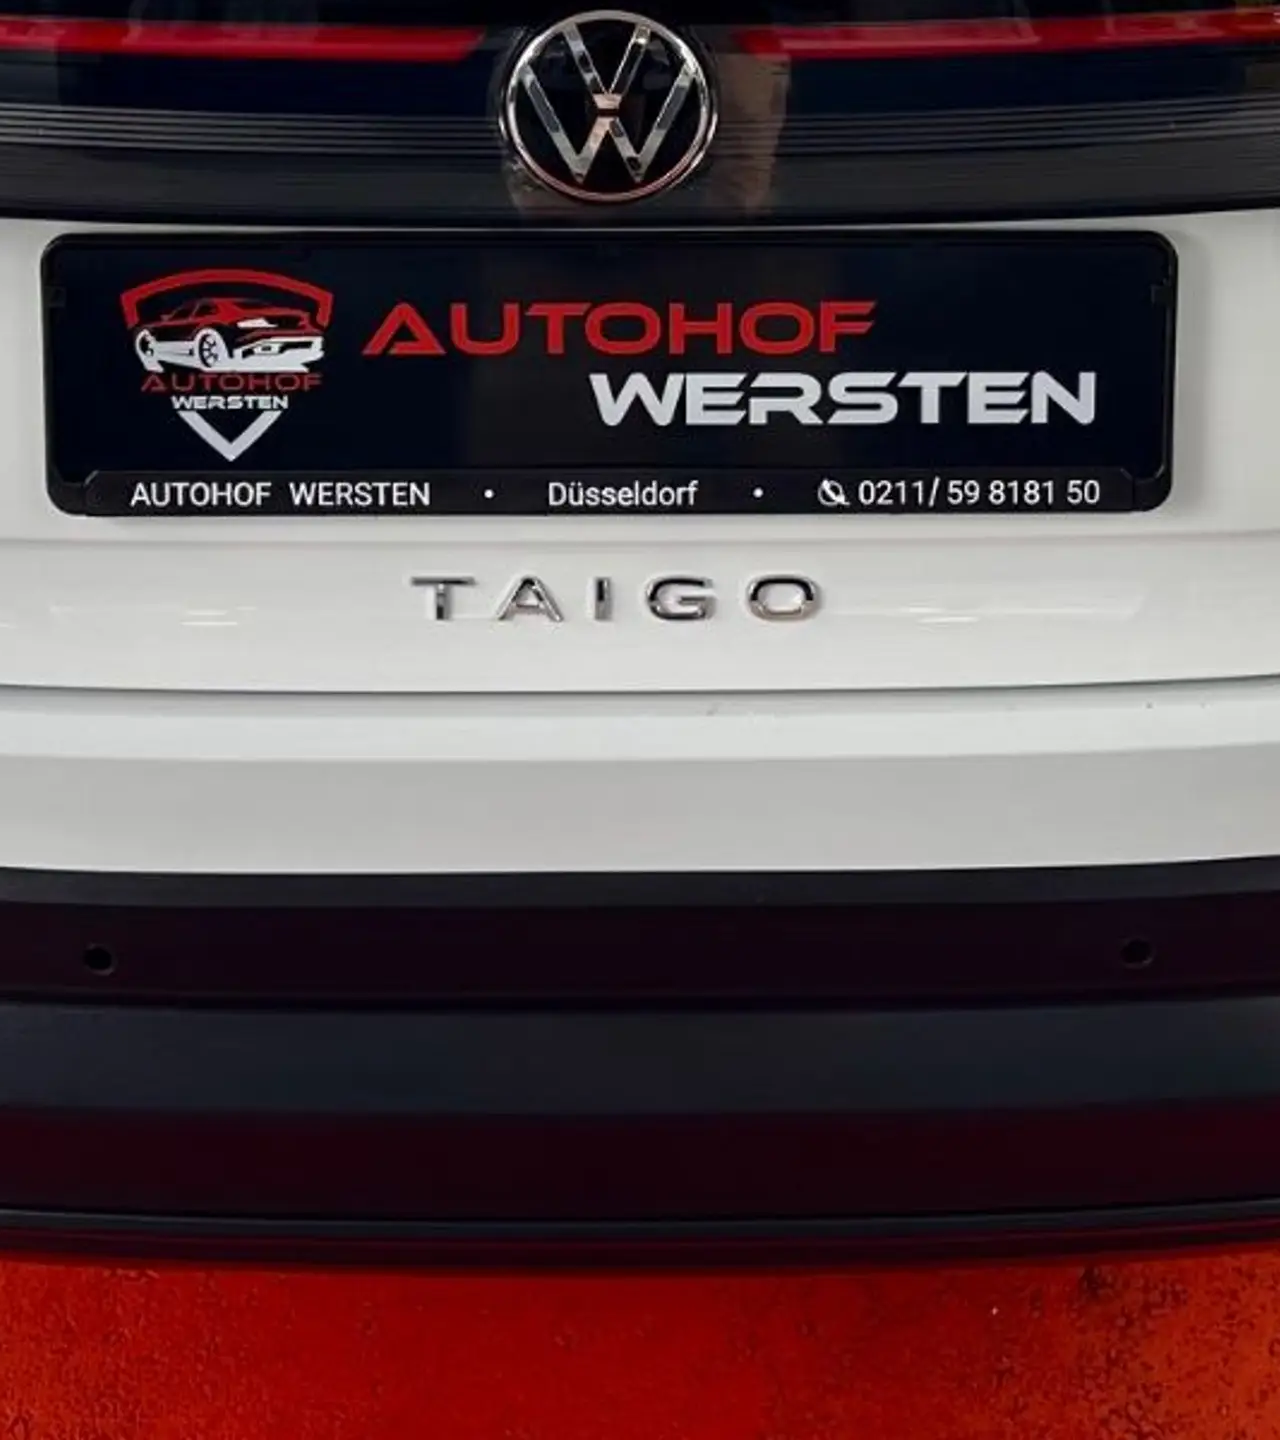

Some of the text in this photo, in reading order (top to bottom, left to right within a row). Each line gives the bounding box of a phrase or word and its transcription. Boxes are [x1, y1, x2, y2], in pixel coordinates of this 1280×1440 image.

[362, 301, 877, 356] AUTOHOF
[140, 372, 323, 392] AUTOHOF
[589, 371, 1097, 427] WERSTEN
[171, 395, 289, 410] WERSTEN
[130, 481, 272, 507] AUTOHOF
[289, 481, 431, 507] WERSTEN
[547, 479, 699, 507] Düsseldorf
[987, 480, 1056, 505] 8181
[1065, 479, 1101, 505] 50
[411, 574, 820, 622] TAIGO
